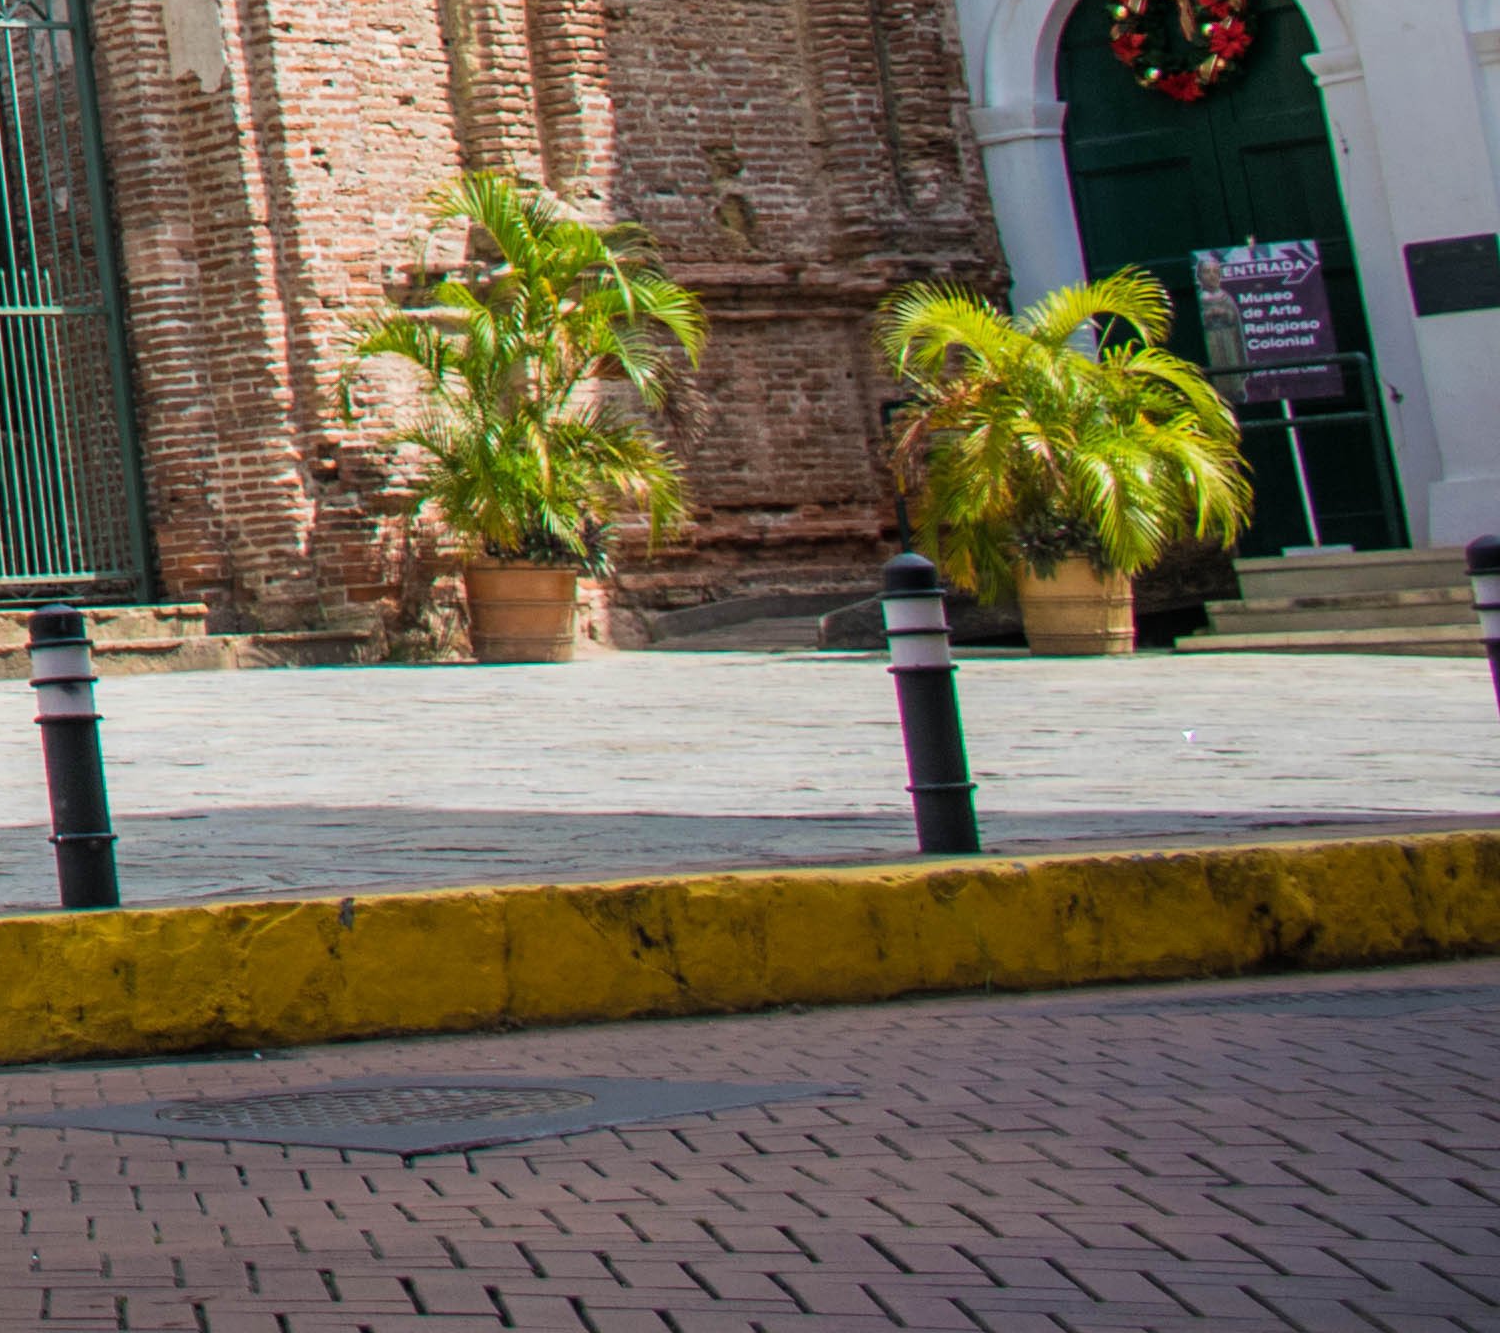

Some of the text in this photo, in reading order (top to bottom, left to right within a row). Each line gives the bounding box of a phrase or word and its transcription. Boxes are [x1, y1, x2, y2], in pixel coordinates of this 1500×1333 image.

[1222, 259, 1308, 278] ENTRADA
[1239, 291, 1293, 304] Museo
[1242, 305, 1302, 319] de Arte
[1244, 320, 1321, 335] Religioso
[1247, 335, 1315, 350] Colonial
